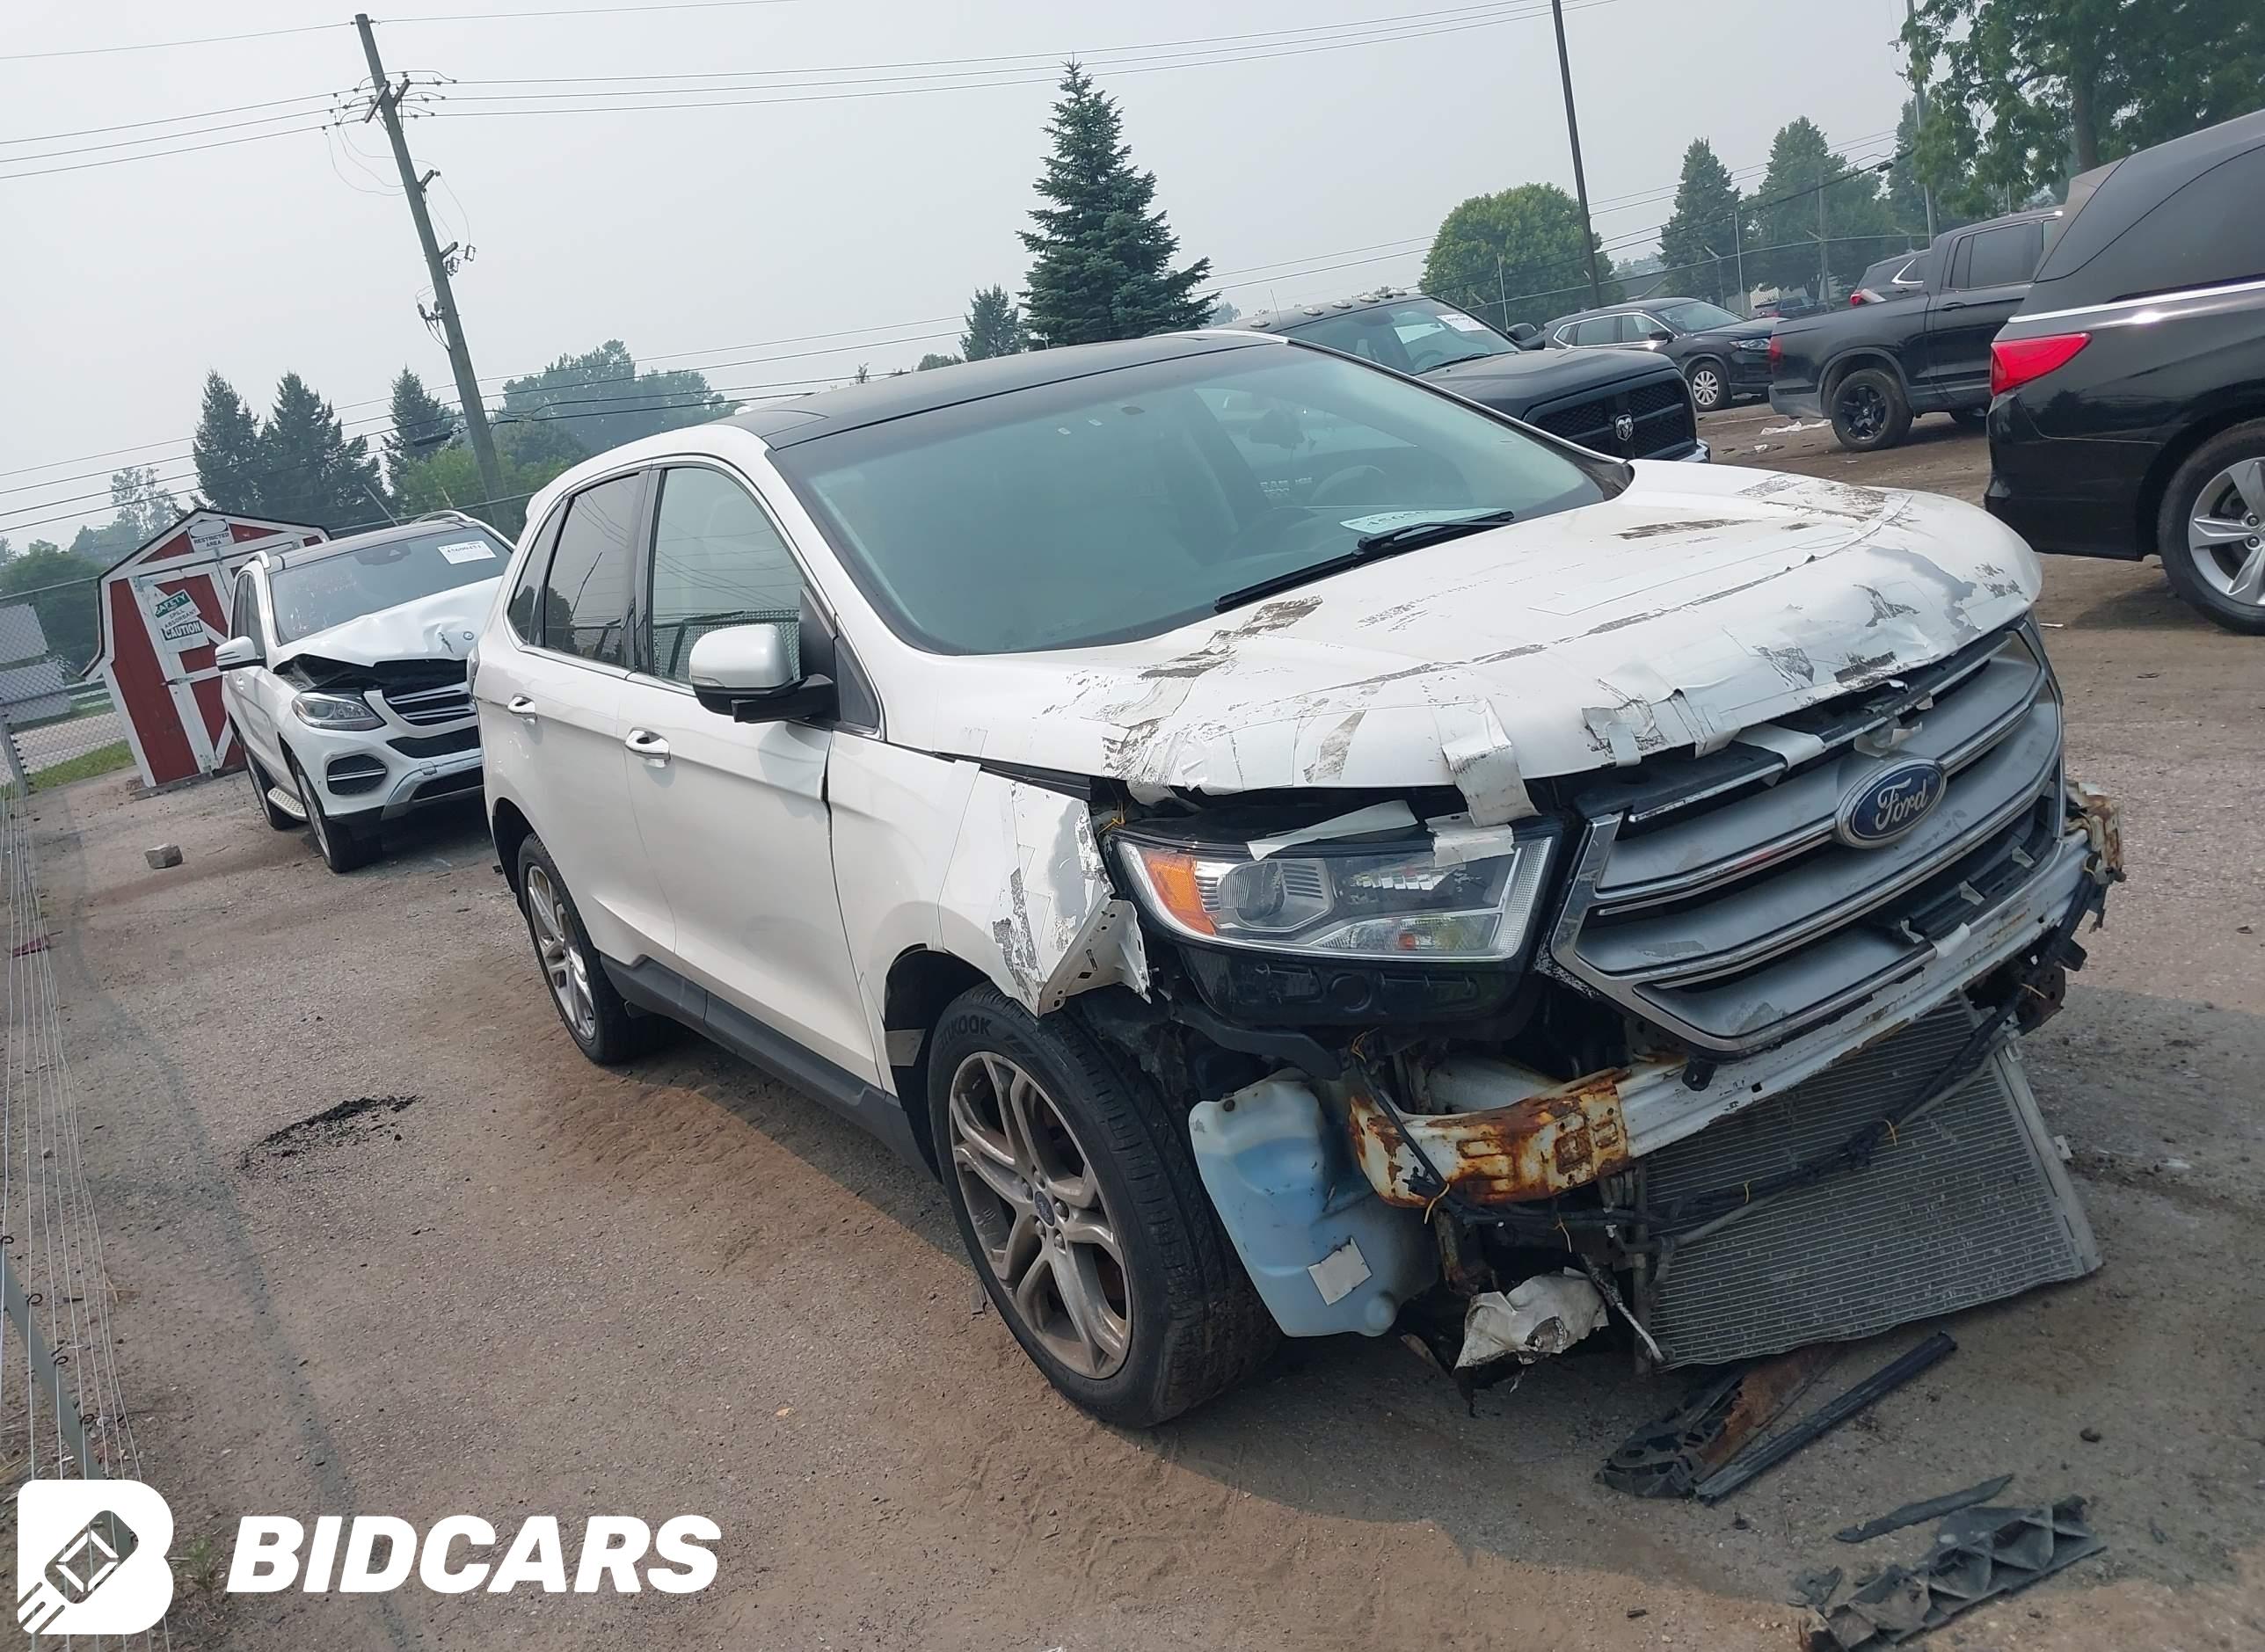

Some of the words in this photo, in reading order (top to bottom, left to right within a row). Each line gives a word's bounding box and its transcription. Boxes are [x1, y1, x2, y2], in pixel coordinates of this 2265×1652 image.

[193, 532, 229, 544] RESTRICTED
[164, 622, 202, 640] CAUTION
[1875, 777, 1928, 832] Ford
